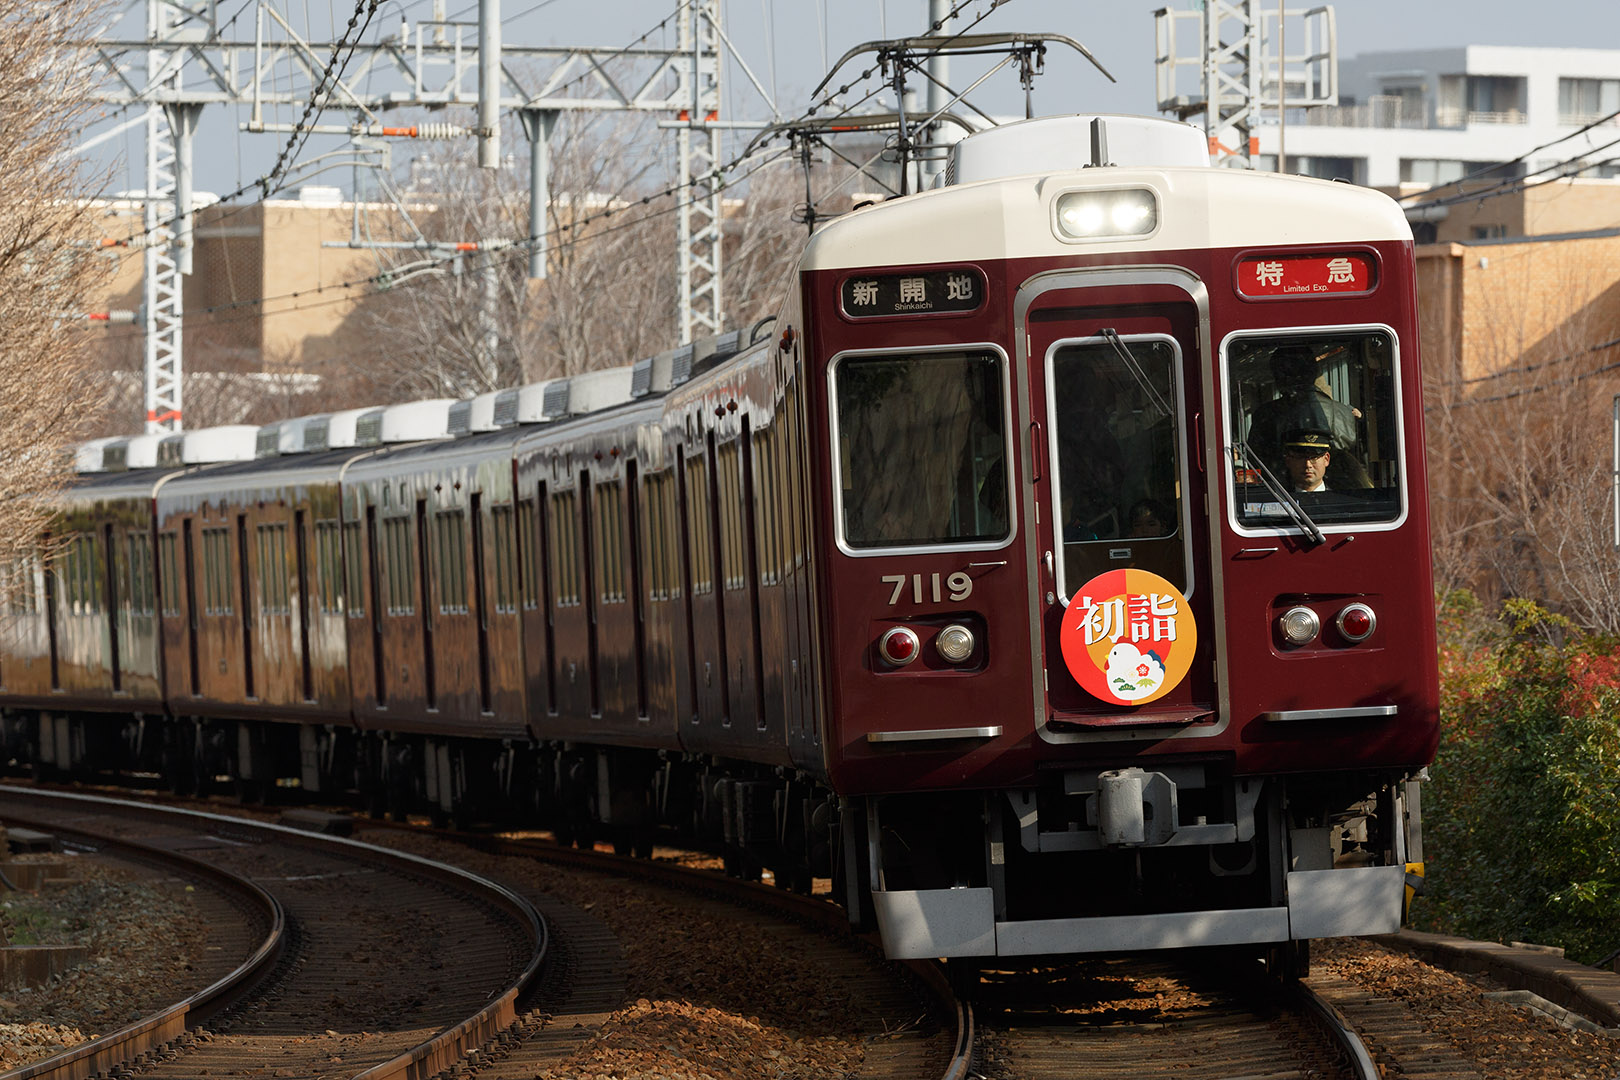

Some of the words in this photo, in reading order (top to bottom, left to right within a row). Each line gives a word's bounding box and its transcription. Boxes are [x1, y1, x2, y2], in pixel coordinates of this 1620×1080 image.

[1256, 258, 1355, 286] 特急
[853, 275, 973, 306] 新開地
[1283, 284, 1310, 293] Limited
[1313, 284, 1329, 292] Exp.
[894, 301, 933, 311] Shinkaichi
[882, 572, 973, 605] 7119
[1076, 593, 1178, 645] 初詣
